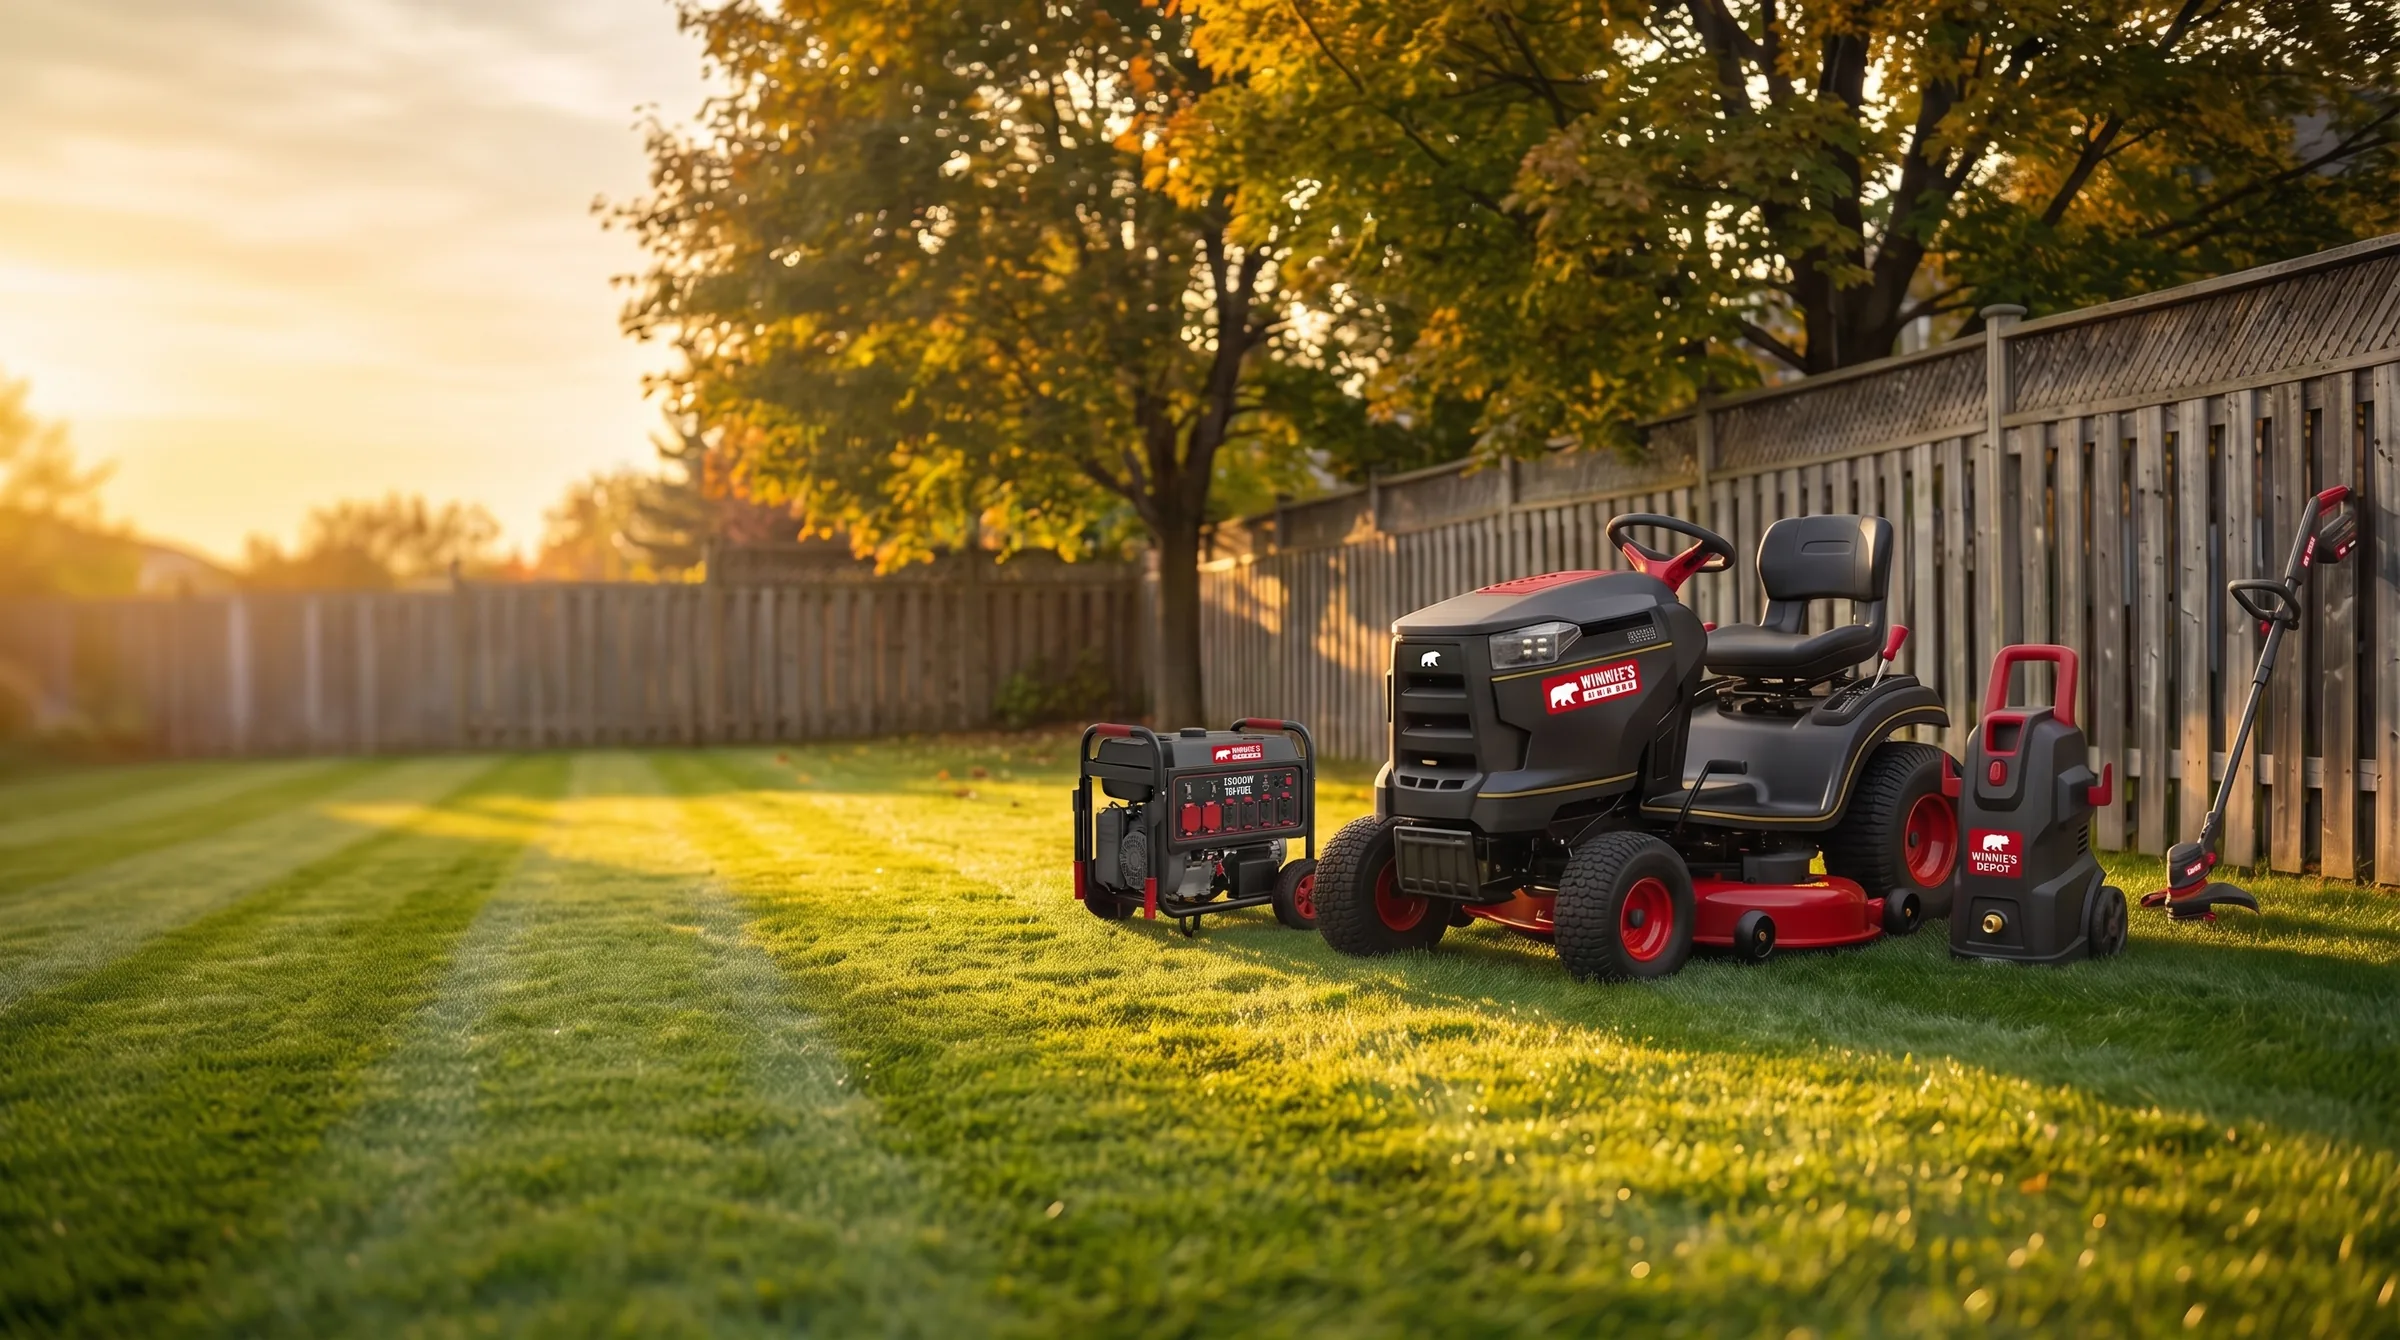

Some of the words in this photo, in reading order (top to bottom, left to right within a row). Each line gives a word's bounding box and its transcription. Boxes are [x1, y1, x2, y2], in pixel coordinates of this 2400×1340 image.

[1580, 665, 1636, 690] WINNIE'S
[1971, 851, 2018, 865] WINNIE'S
[1976, 862, 2011, 874] DEPOT
